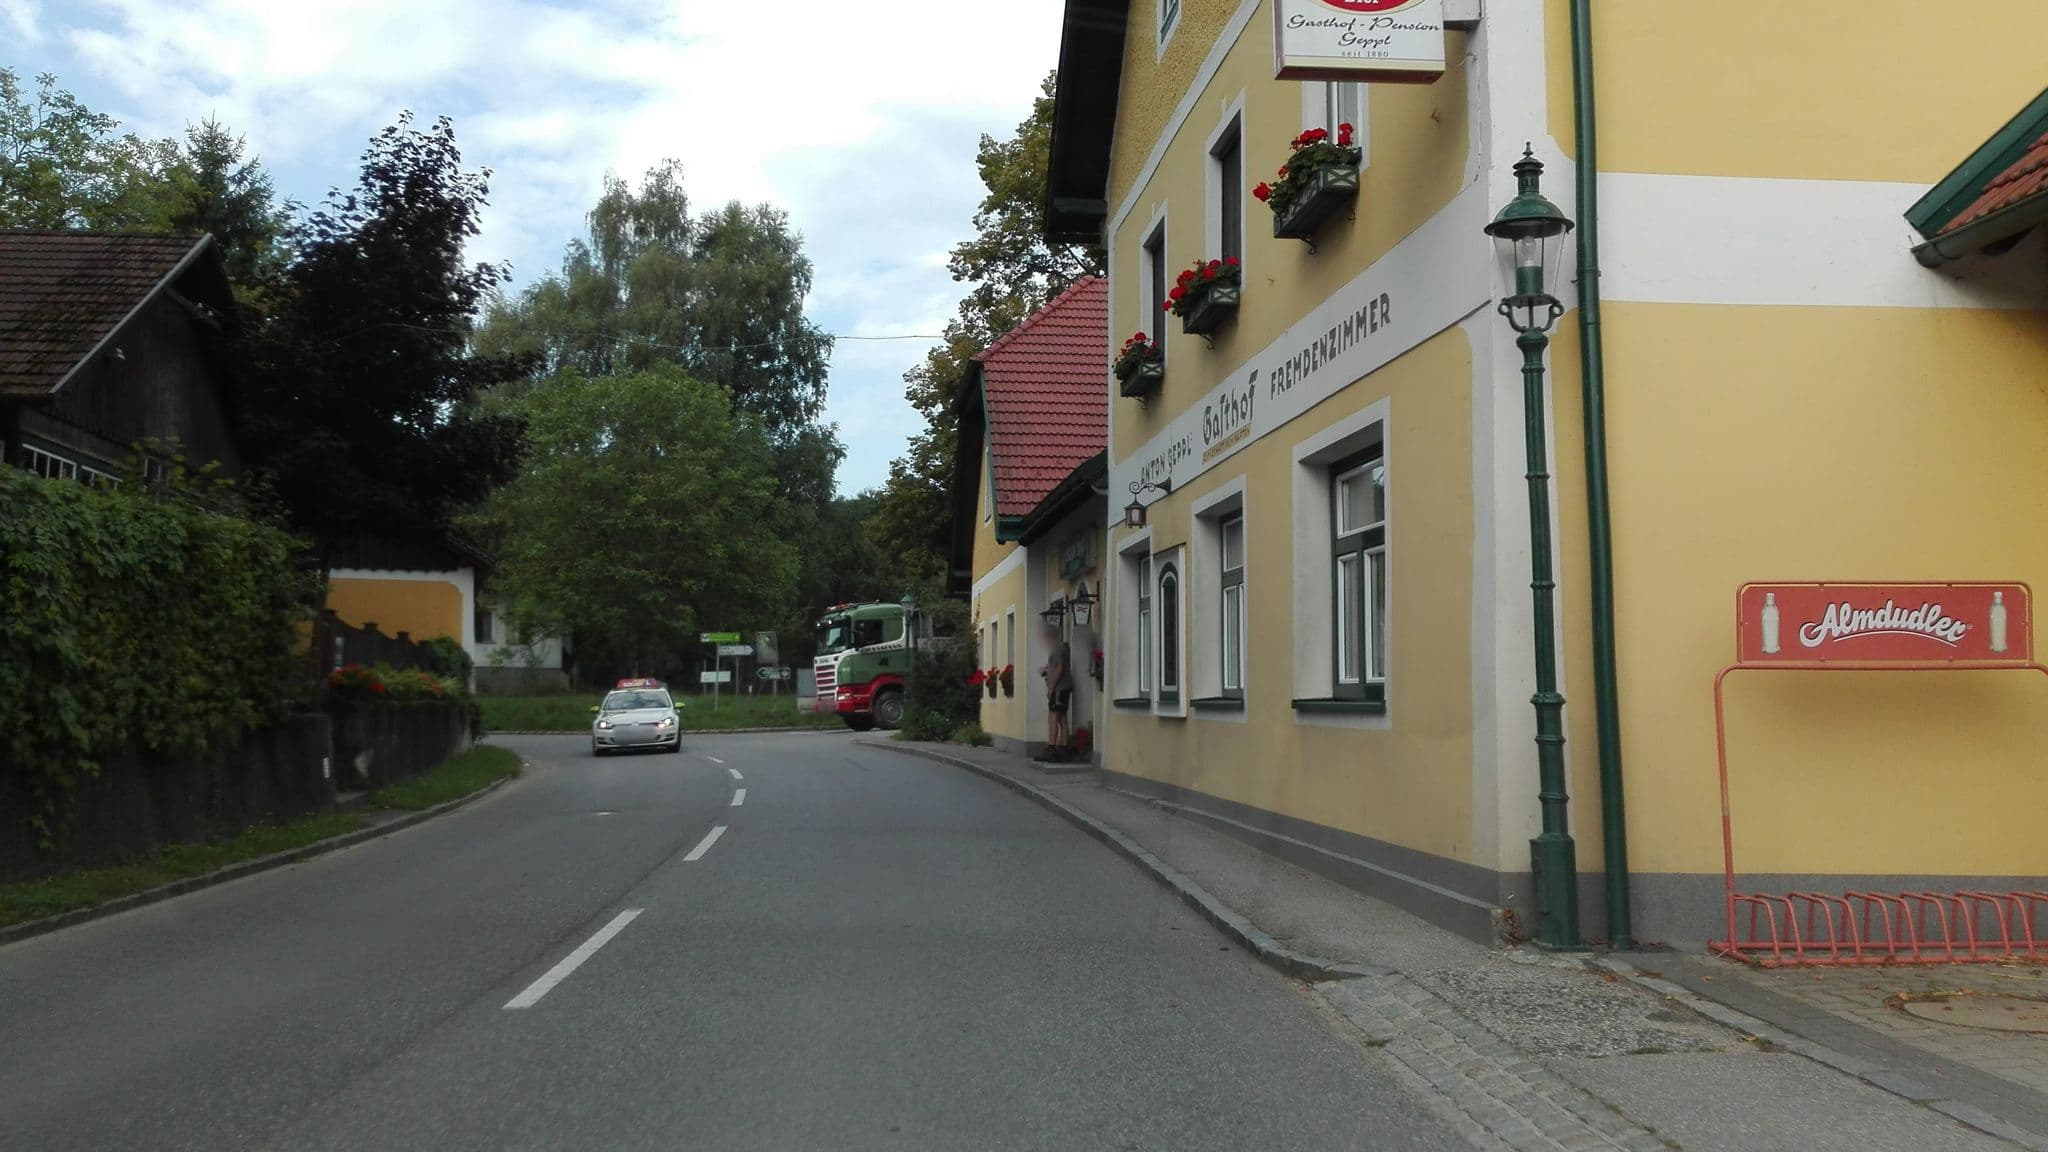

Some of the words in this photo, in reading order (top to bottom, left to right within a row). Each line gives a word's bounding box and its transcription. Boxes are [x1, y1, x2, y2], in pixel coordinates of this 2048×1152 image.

[1286, 14, 1356, 32] Gasthof
[1368, 17, 1441, 31] Pension
[1338, 32, 1392, 49] Geppl
[1141, 452, 1166, 485] ANTON
[1168, 434, 1192, 475] GEPPL
[1270, 292, 1392, 401] FREMDENZIMMER
[1799, 599, 1968, 648] Almdudler
